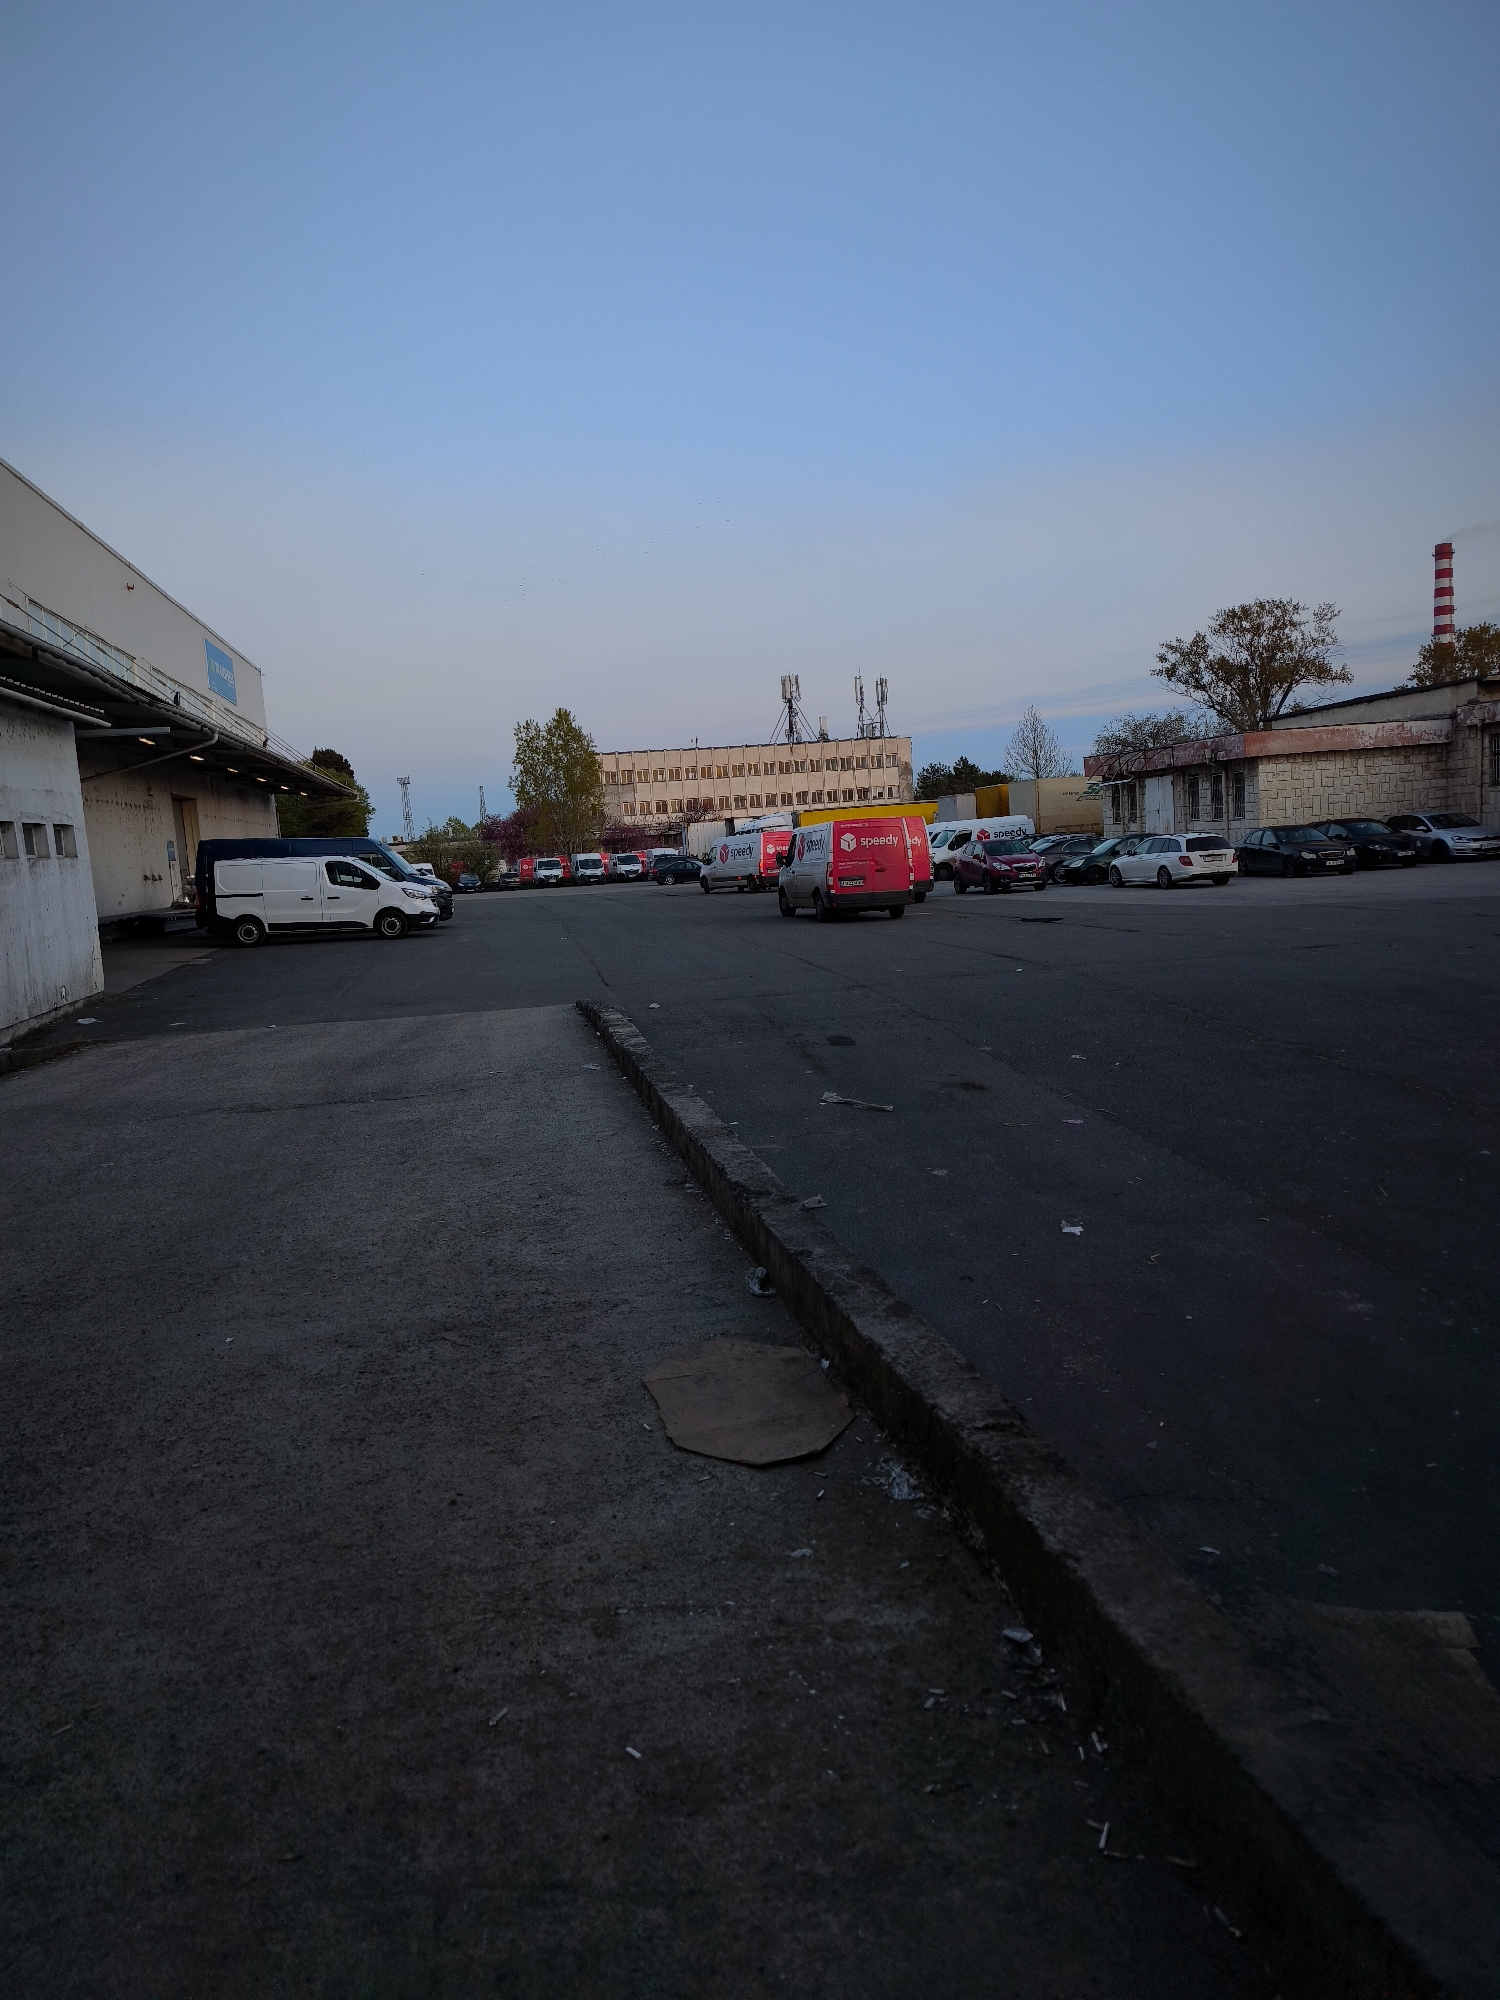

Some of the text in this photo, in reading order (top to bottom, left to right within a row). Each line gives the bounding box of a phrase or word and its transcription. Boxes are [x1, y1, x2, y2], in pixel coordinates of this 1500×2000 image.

[806, 833, 826, 855] speedy
[860, 833, 899, 849] speedy
[731, 843, 754, 860] speedy
